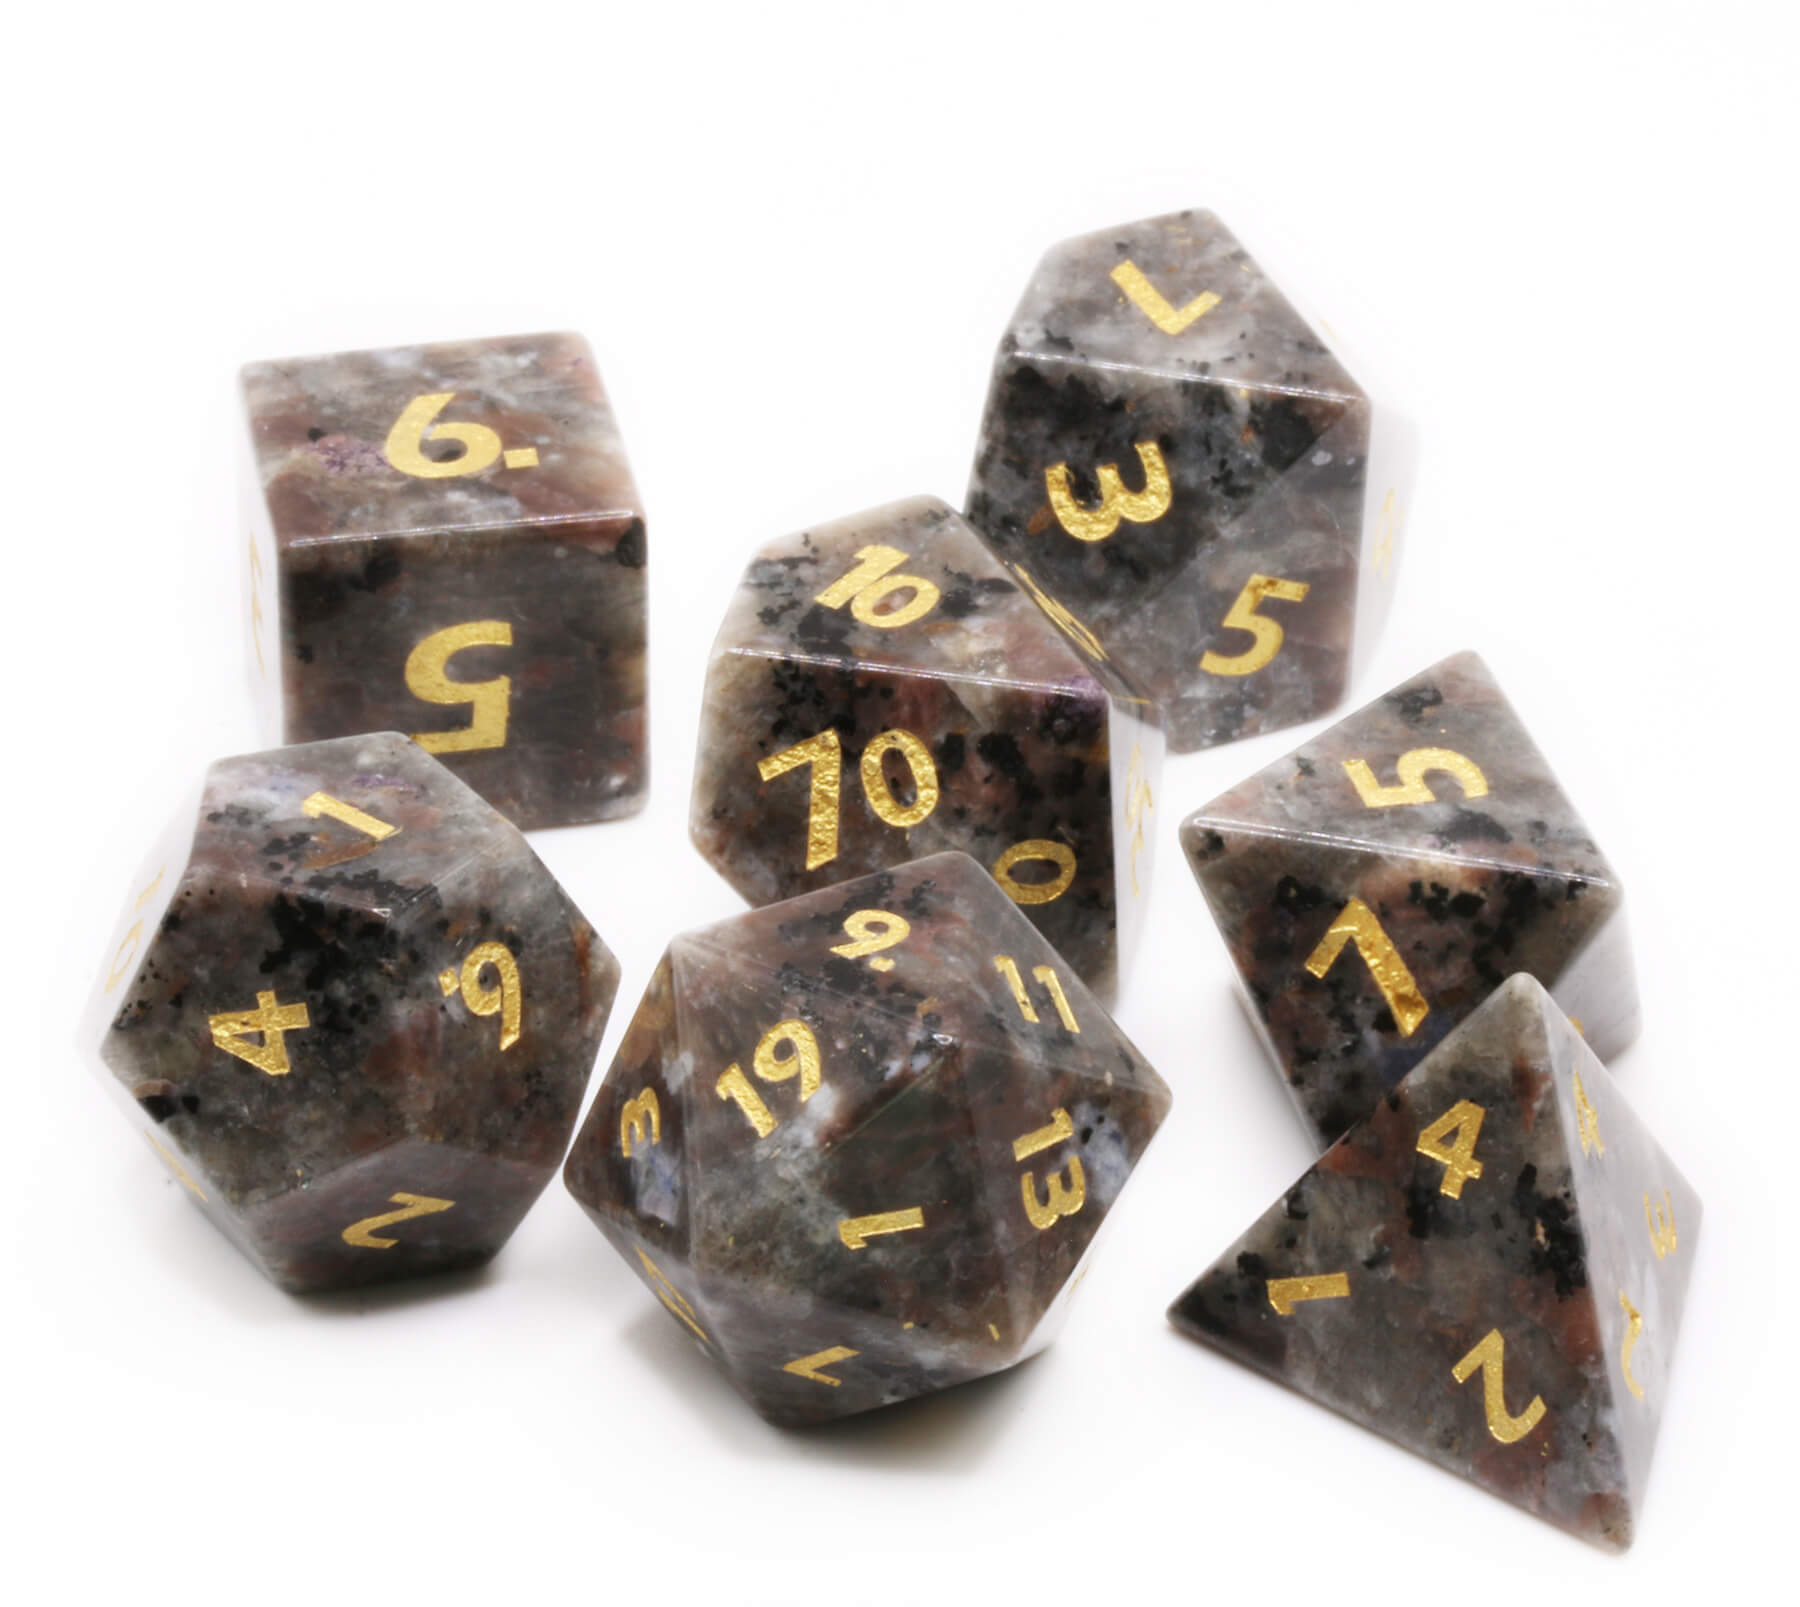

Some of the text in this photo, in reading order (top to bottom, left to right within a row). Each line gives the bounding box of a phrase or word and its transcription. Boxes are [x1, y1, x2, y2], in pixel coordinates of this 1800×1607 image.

[1045, 440, 1173, 542] 3
[813, 545, 940, 629] 10
[1200, 575, 1310, 676] 5
[405, 620, 513, 755] 5
[303, 792, 398, 841] 1
[757, 729, 940, 871] 70
[1342, 746, 1489, 809] 5
[993, 955, 1080, 1034] 11
[1304, 897, 1430, 1038] 7
[208, 990, 310, 1076] 4
[715, 1018, 822, 1138] 19
[620, 1087, 661, 1158] 3
[1012, 1107, 1086, 1230] 13
[1415, 1099, 1487, 1200] 4
[341, 1191, 456, 1249] 2
[837, 1205, 925, 1250] 1
[1266, 1272, 1352, 1315] 1
[1451, 1328, 1547, 1445] 2
